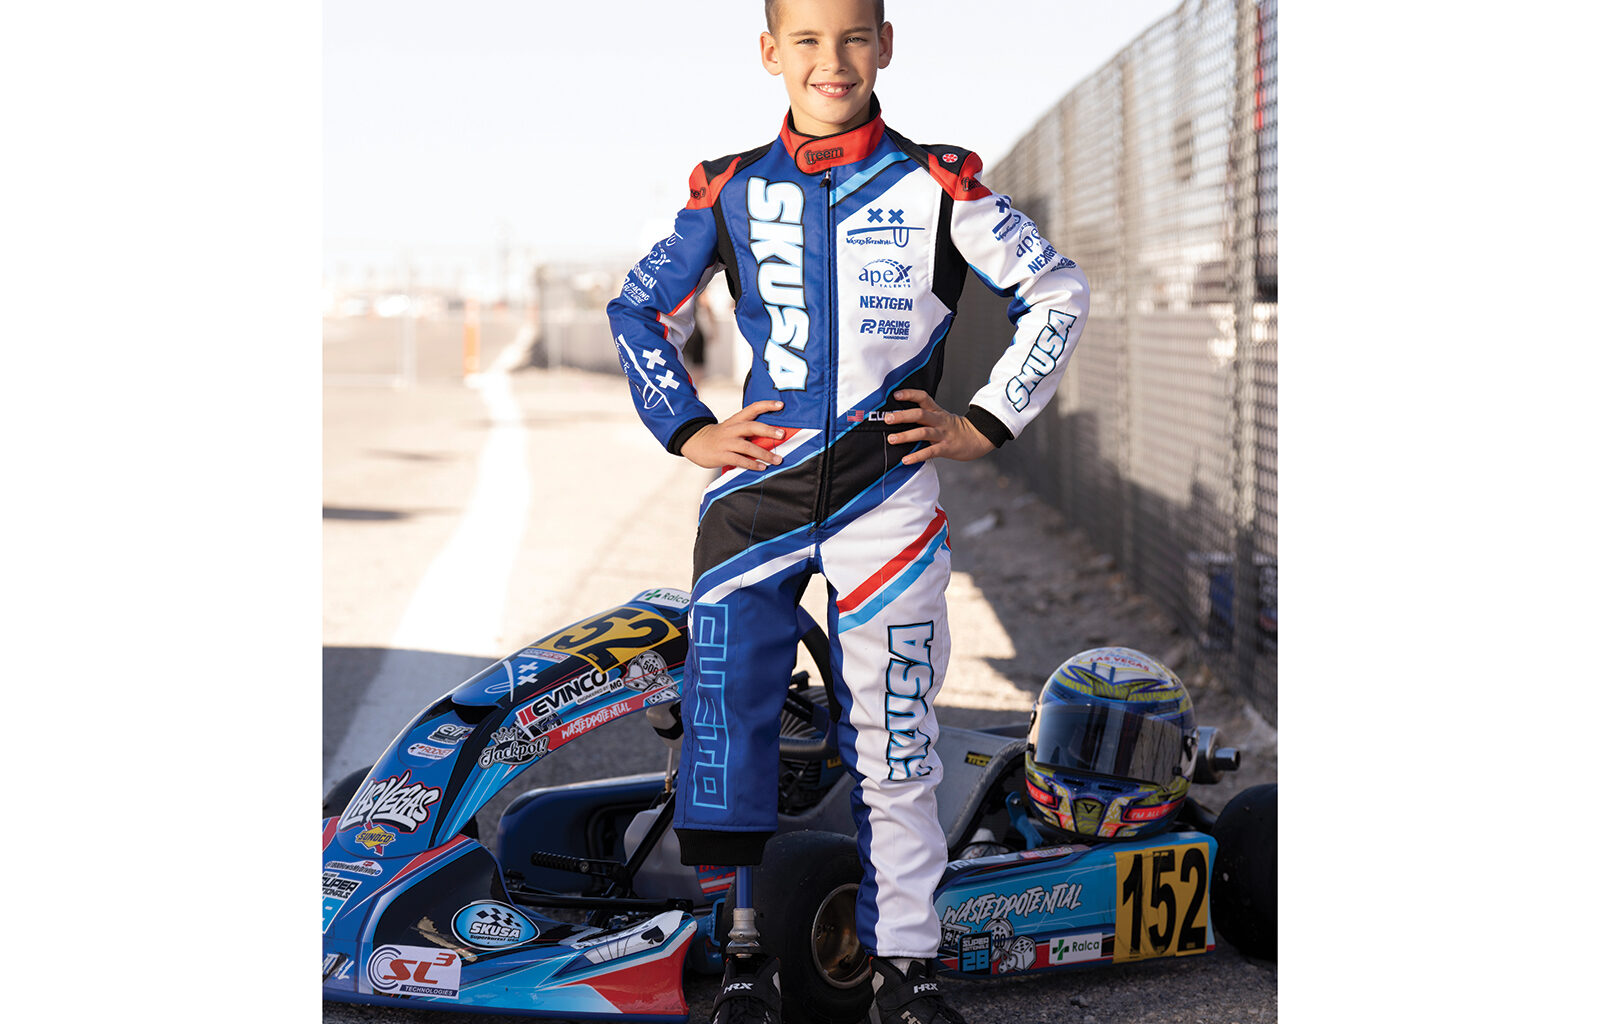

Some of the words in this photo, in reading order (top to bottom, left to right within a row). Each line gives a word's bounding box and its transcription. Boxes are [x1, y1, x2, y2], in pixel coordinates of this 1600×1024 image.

[804, 147, 844, 165] freem
[1016, 228, 1041, 258] ape
[746, 176, 810, 391] SKUSA
[860, 296, 913, 311] NEXTGEN
[877, 327, 909, 336] FUTURE
[878, 320, 911, 328] RACING
[1006, 309, 1077, 413] SKUSA
[662, 592, 690, 605] Ralca
[609, 679, 622, 690] MG
[532, 669, 608, 717] EVINCO
[561, 702, 632, 740] WASTEDPOTENTIAL
[339, 778, 387, 831] LAS
[366, 771, 441, 824] VEGAS
[358, 832, 392, 844] SUNOCO
[943, 884, 1083, 925] WASTEDPOTENTIAL
[1122, 848, 1208, 954] 152
[469, 922, 521, 939] SKUSA
[963, 937, 989, 946] SUPER
[1072, 940, 1100, 953] Ralca
[963, 949, 990, 972] 28
[405, 986, 453, 996] TECHNOLOGIES
[723, 982, 754, 994] HRX
[913, 983, 939, 994] HRX
